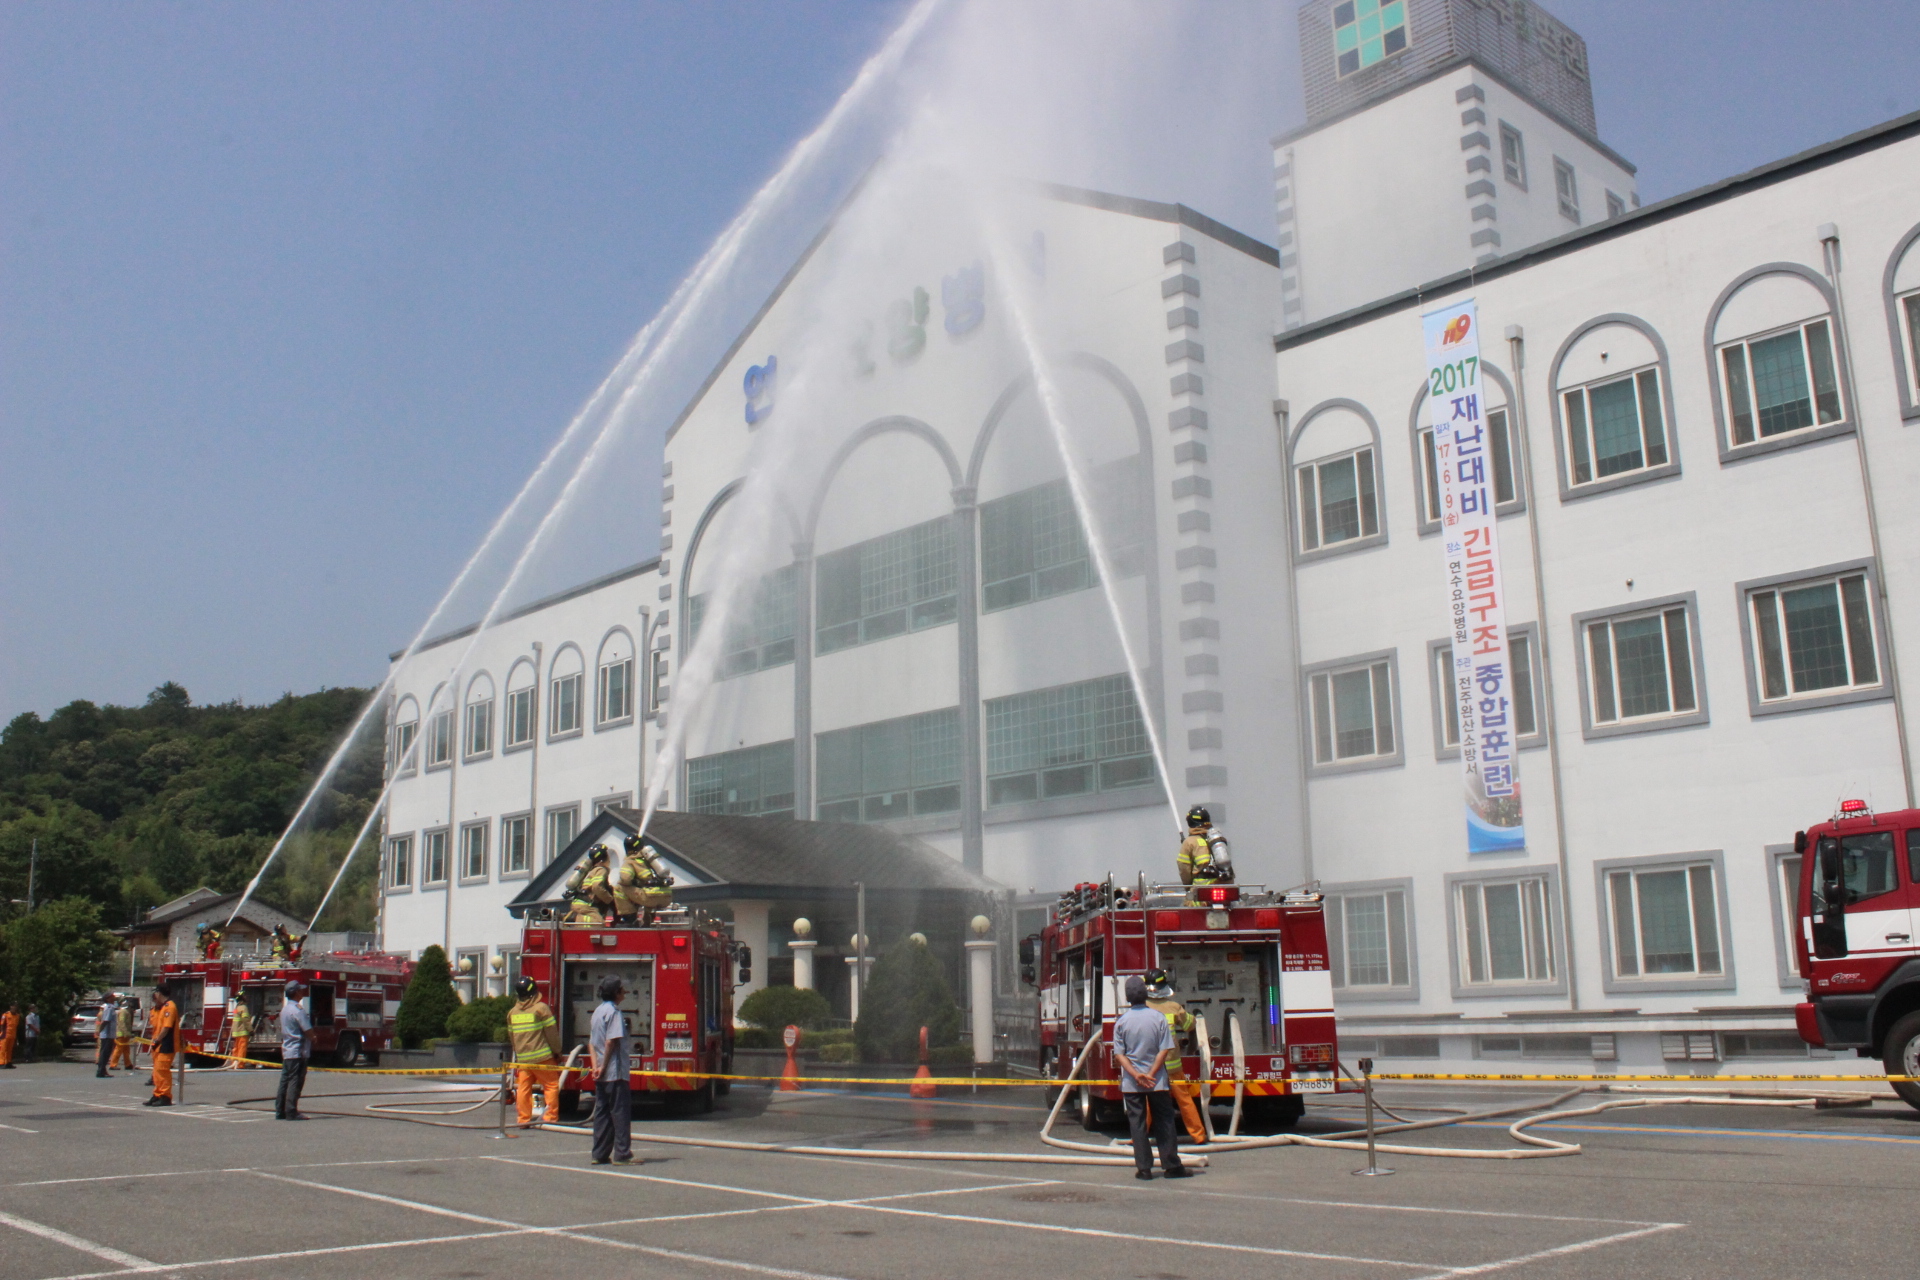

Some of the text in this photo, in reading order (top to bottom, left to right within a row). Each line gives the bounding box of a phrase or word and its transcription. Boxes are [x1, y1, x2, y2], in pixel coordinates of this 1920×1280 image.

[1430, 356, 1478, 397] 2017
[1435, 422, 1450, 433] 일자
[1450, 393, 1488, 516] 재난대비
[1446, 541, 1462, 553] 장소
[1448, 560, 1468, 644] 연수요양병원
[1463, 526, 1501, 656] 긴급구조
[1455, 656, 1472, 668] 주관
[1458, 676, 1478, 776] 전주완산소방서
[1475, 662, 1515, 798] 종합훈련
[1214, 1066, 1252, 1078] 전라도
